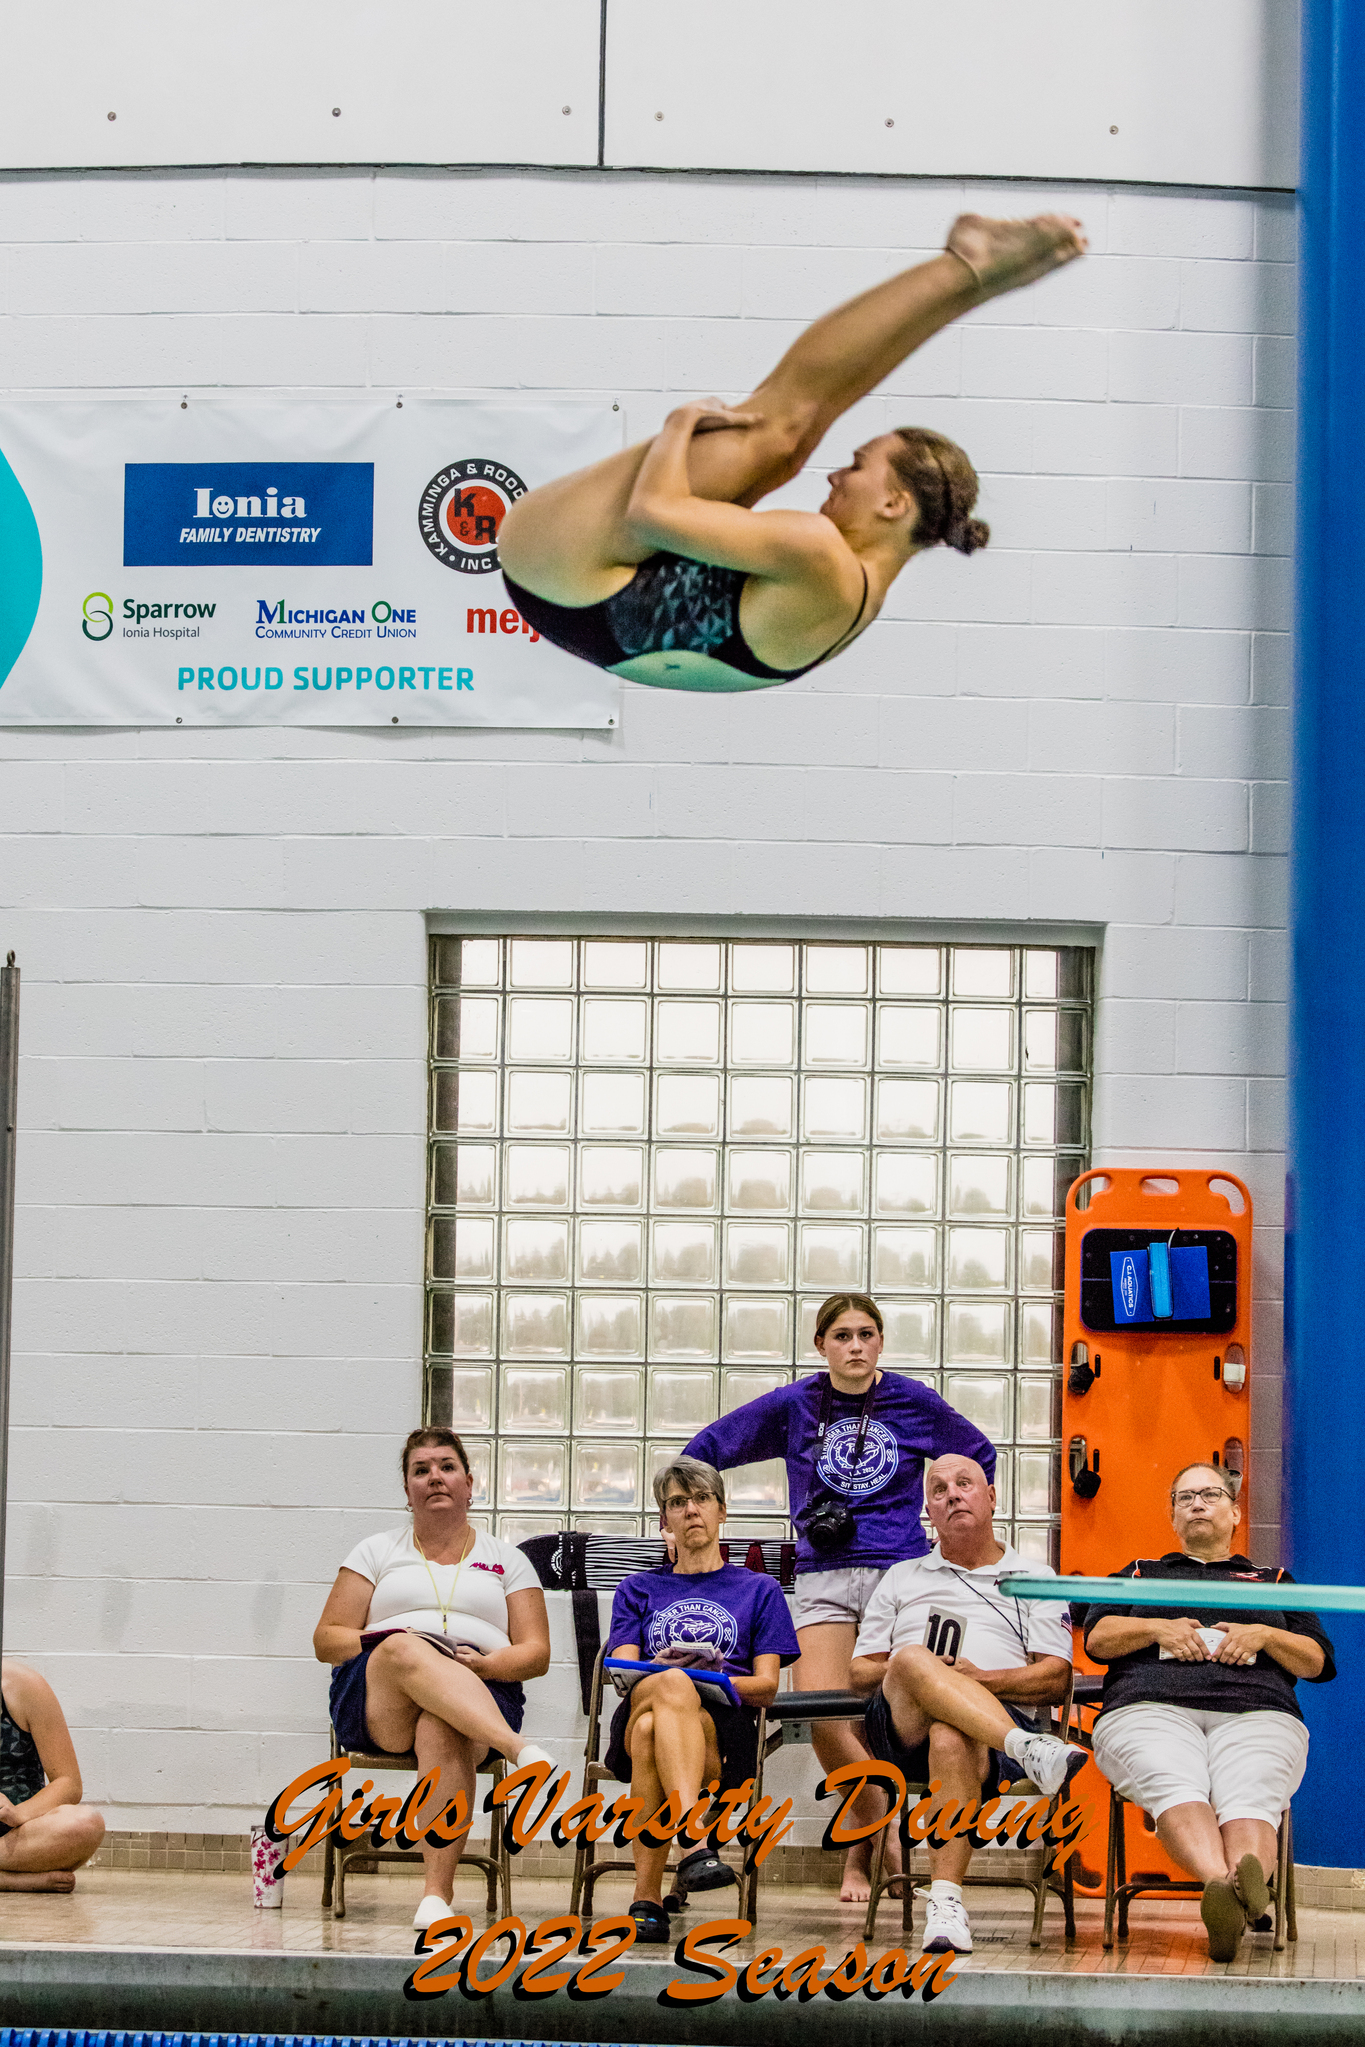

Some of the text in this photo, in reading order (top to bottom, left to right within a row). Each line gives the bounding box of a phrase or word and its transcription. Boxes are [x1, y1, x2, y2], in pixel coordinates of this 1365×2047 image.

[422, 467, 461, 556] KAMMINGA
[466, 463, 478, 475] &
[179, 527, 321, 543] FAMILY DENTISTRY
[460, 557, 493, 571] INC
[122, 598, 217, 625] Sparrow
[122, 626, 200, 641] Ionia Hospital
[178, 665, 475, 691] PROUD SUPPORTER
[653, 1603, 729, 1636] STROER THAN CANCER
[927, 1613, 961, 1666] 10
